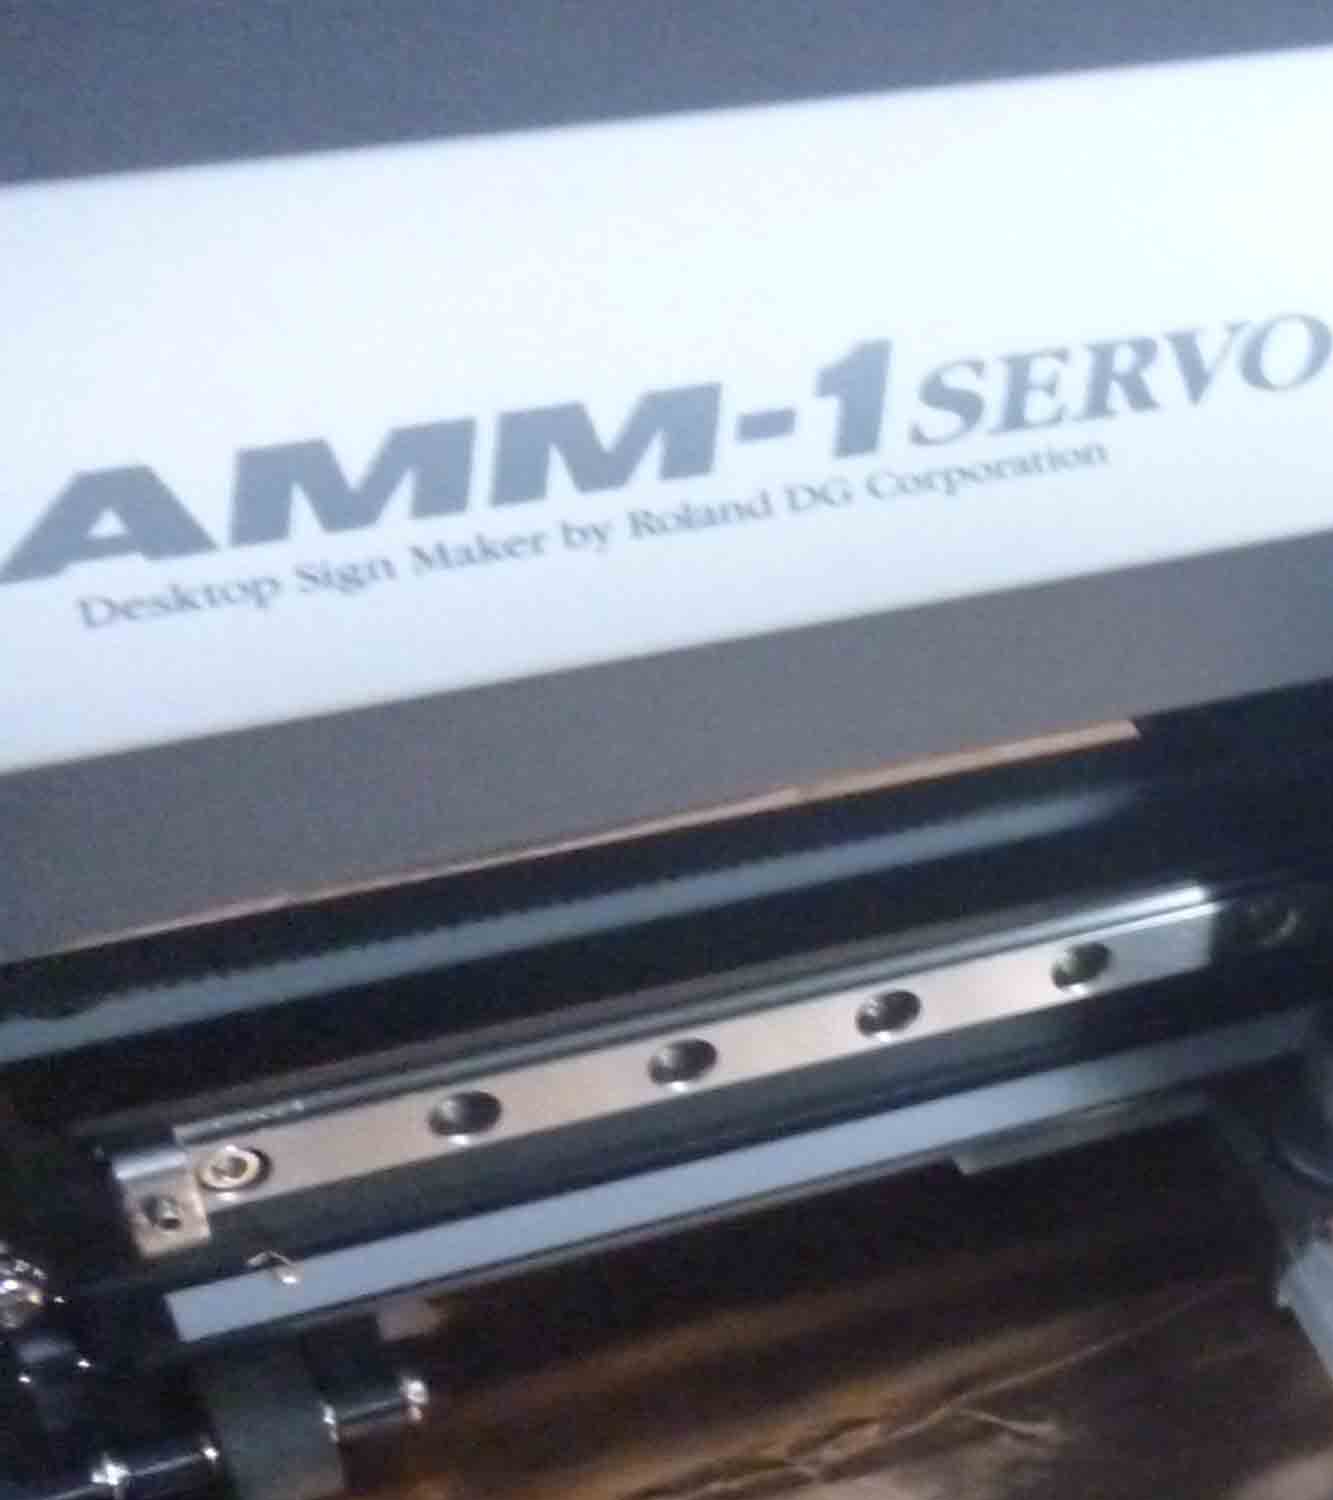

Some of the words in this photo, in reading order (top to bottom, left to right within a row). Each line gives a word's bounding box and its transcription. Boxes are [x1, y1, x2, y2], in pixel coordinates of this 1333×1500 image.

[909, 313, 1333, 447] SERVO
[78, 571, 281, 629] Desktop
[294, 552, 398, 592] Sign
[409, 526, 548, 576] Maker
[561, 517, 612, 553] by
[627, 489, 774, 541] Roland
[785, 475, 854, 515] DG
[866, 440, 1110, 499] Corporation
